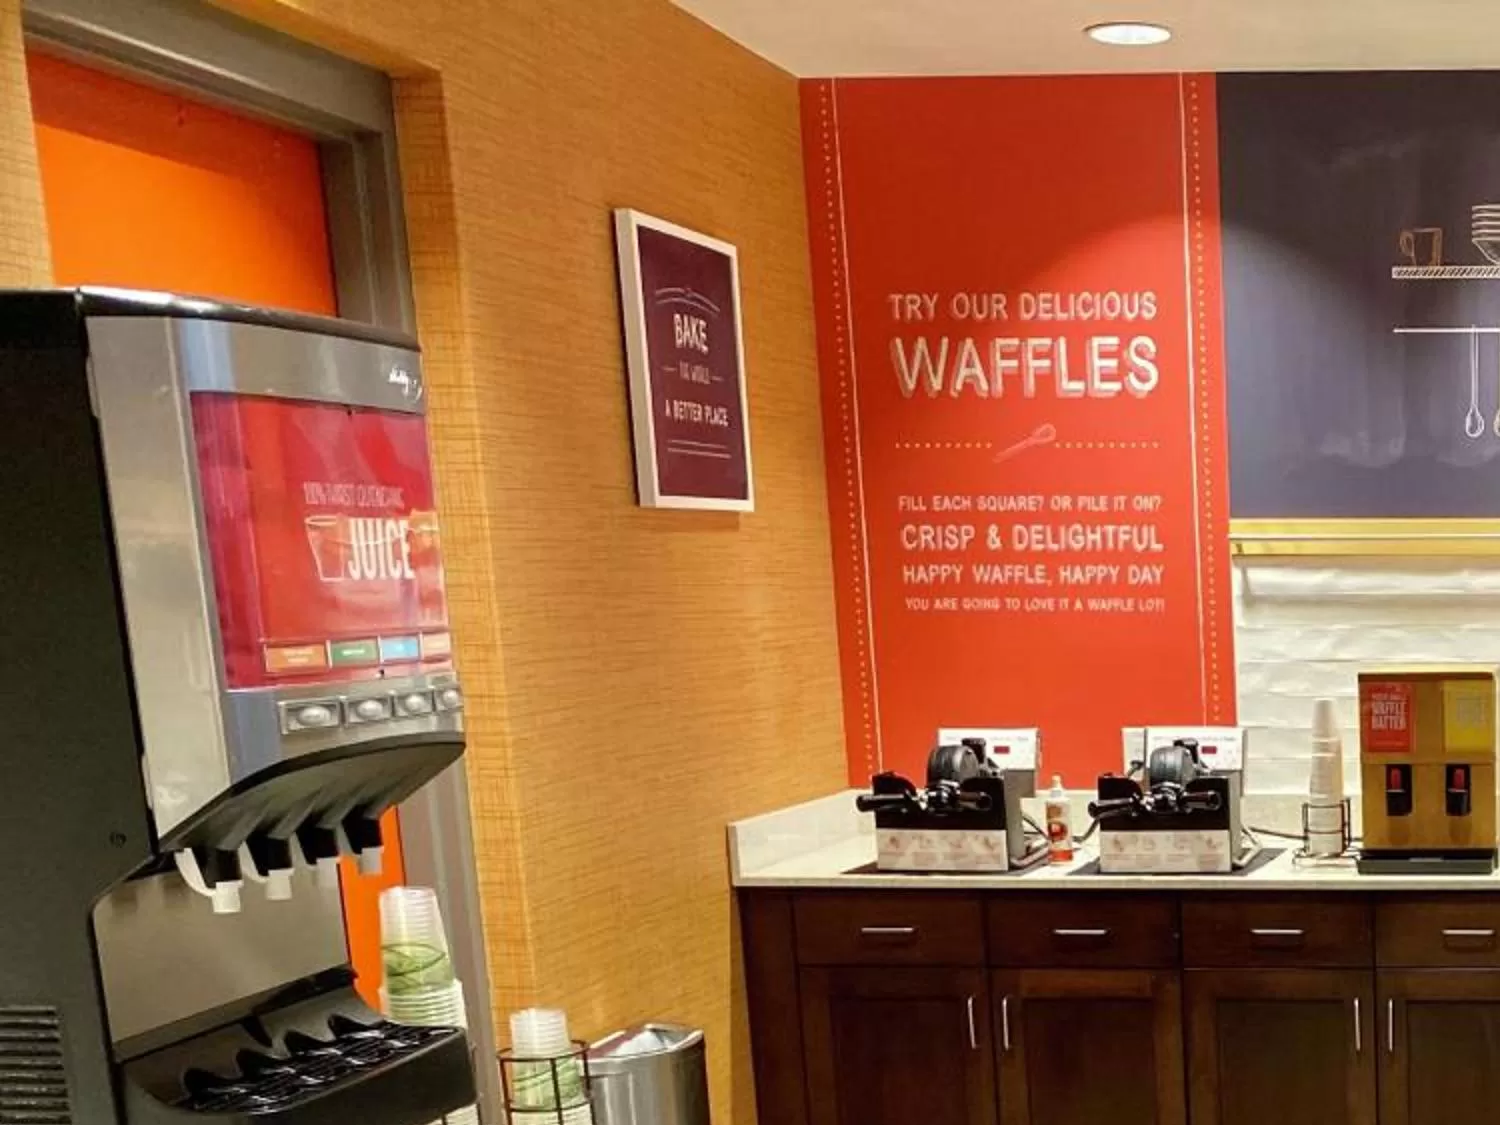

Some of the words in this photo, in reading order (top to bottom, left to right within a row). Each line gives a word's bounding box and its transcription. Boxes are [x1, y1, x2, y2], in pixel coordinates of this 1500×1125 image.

[890, 292, 939, 322] TRY
[952, 291, 1009, 321] OUR
[1018, 290, 1158, 321] DELICIOUS
[673, 313, 709, 355] BAKE
[891, 335, 1160, 399] WAFFLES
[898, 495, 927, 512] FILL
[932, 495, 972, 512] EACH
[976, 495, 1044, 512] SQUARE?
[1049, 495, 1072, 512] OR
[1077, 495, 1109, 512] PILE
[1113, 495, 1128, 512] IT
[347, 517, 417, 580] JUICE
[902, 524, 976, 551] CRISP
[986, 524, 1003, 550] &
[1011, 524, 1165, 551] DELIGHTFUL
[902, 563, 963, 584] HAPPY
[971, 563, 1052, 587] WAFFLE,
[1058, 564, 1121, 585] HAPPY
[1127, 564, 1165, 585] DAY
[904, 597, 929, 612] YOU
[934, 597, 958, 612] ARE
[1005, 597, 1022, 612] TO
[1024, 597, 1055, 612] LOVE
[1073, 597, 1083, 612] A
